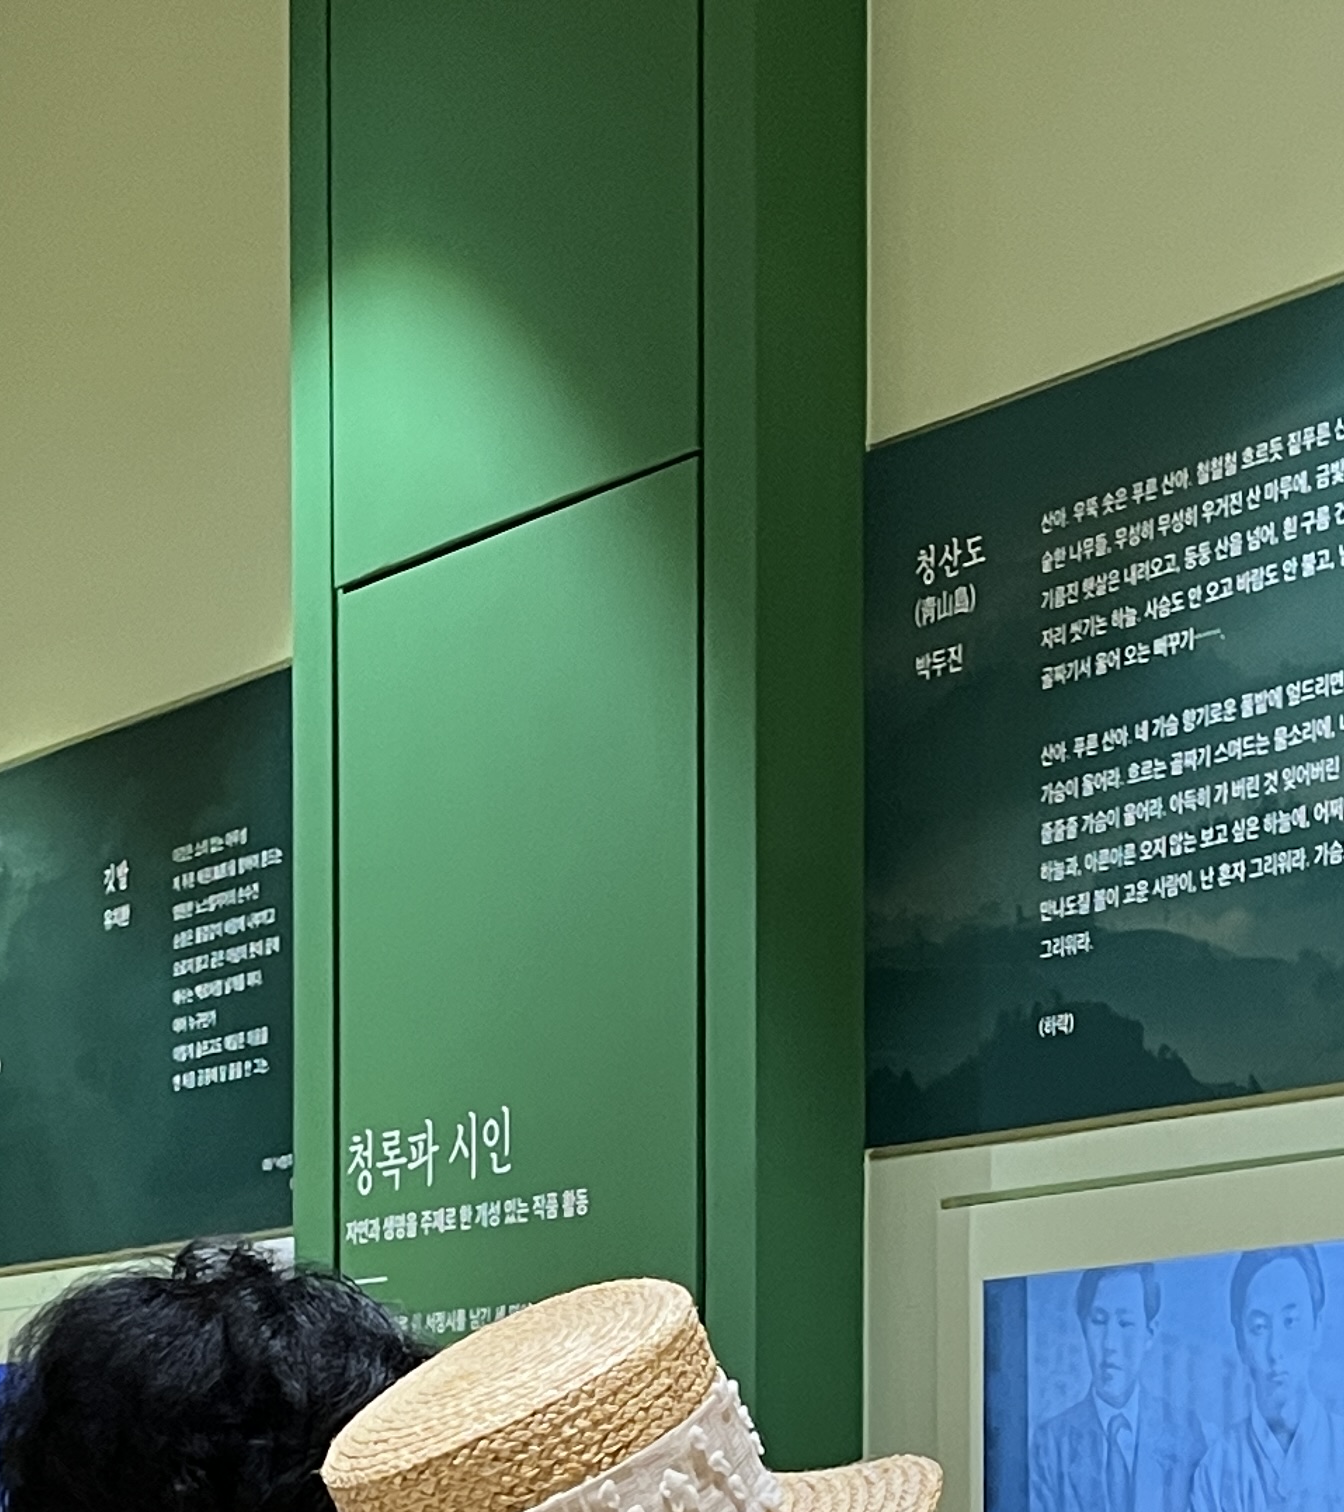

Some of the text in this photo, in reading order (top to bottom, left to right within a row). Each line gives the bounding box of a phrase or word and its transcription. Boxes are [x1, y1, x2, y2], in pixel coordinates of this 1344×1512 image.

[915, 535, 985, 584] 청산도
[915, 643, 962, 679] 박두진
[347, 1105, 512, 1196] 청록파 시인
